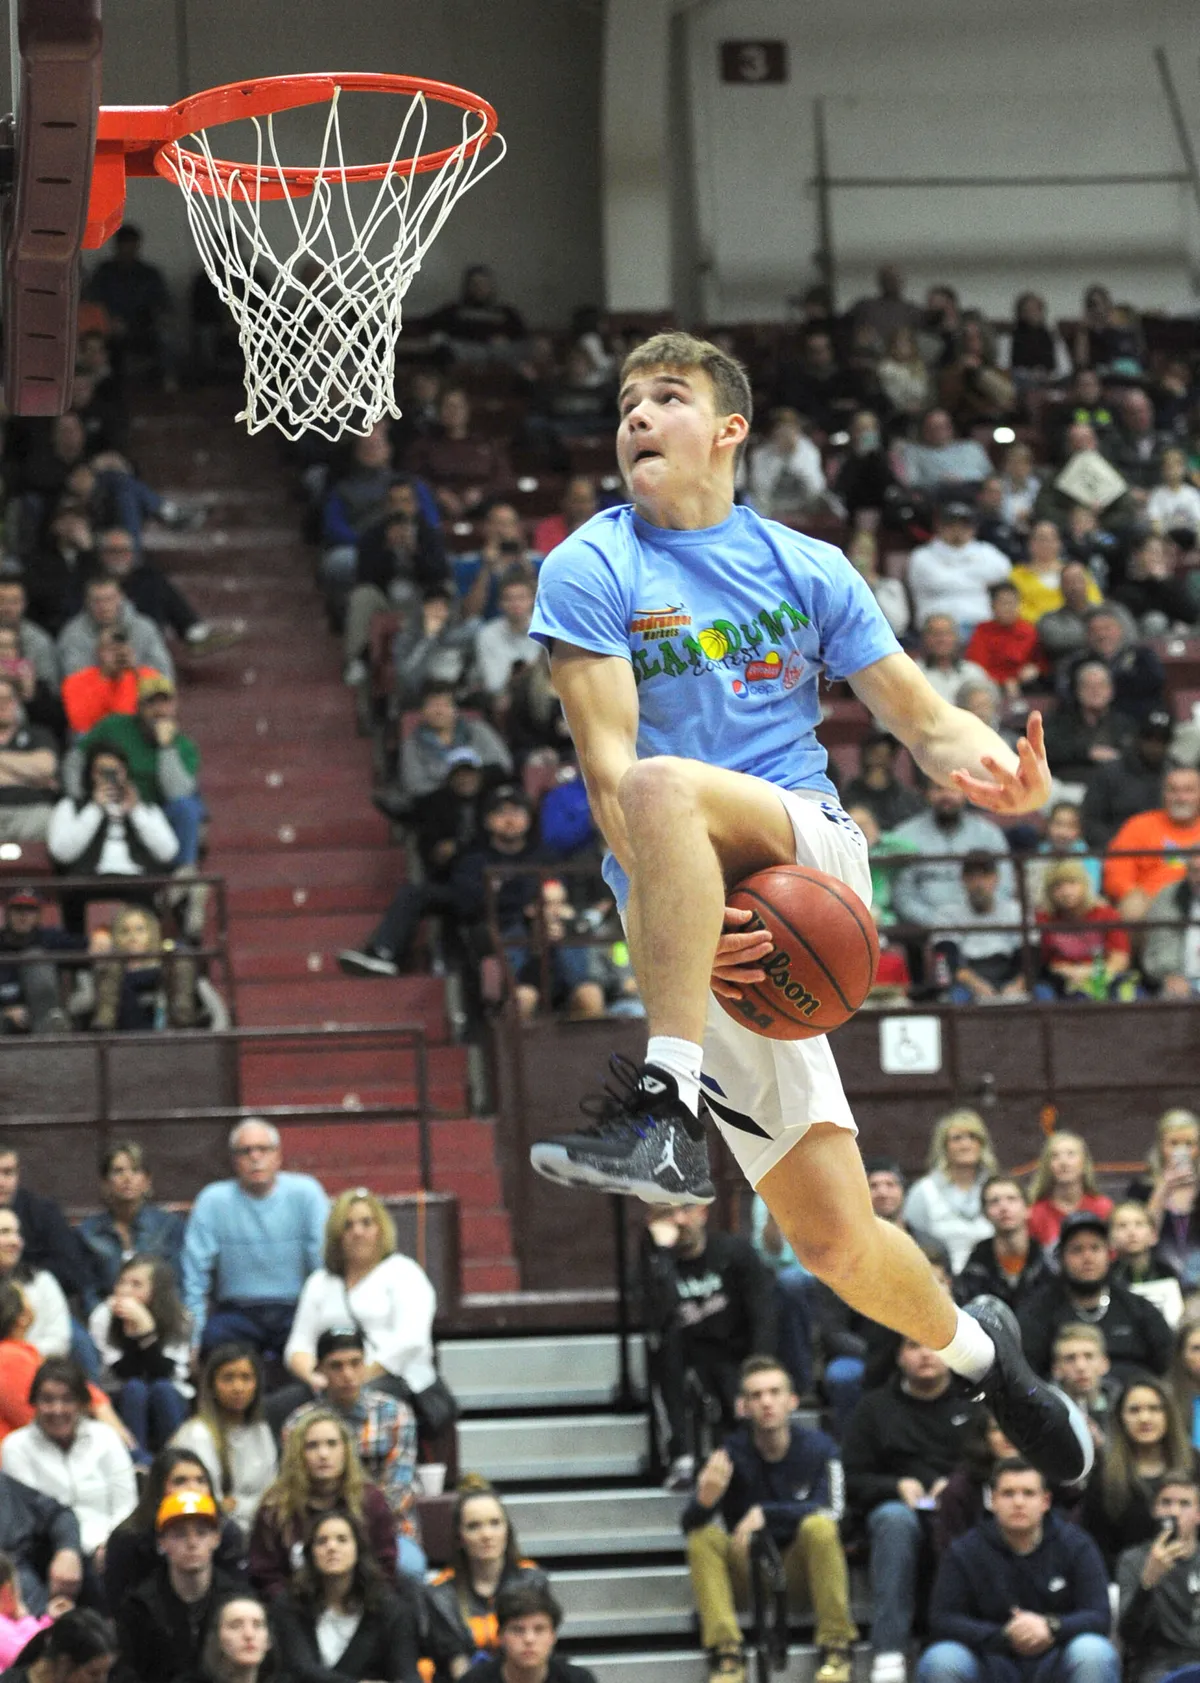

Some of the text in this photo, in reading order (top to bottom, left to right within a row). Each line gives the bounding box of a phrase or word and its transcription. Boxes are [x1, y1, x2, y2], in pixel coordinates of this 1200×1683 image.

[739, 47, 768, 80] 3
[713, 600, 810, 654] DUNK
[738, 907, 822, 1018] lson
